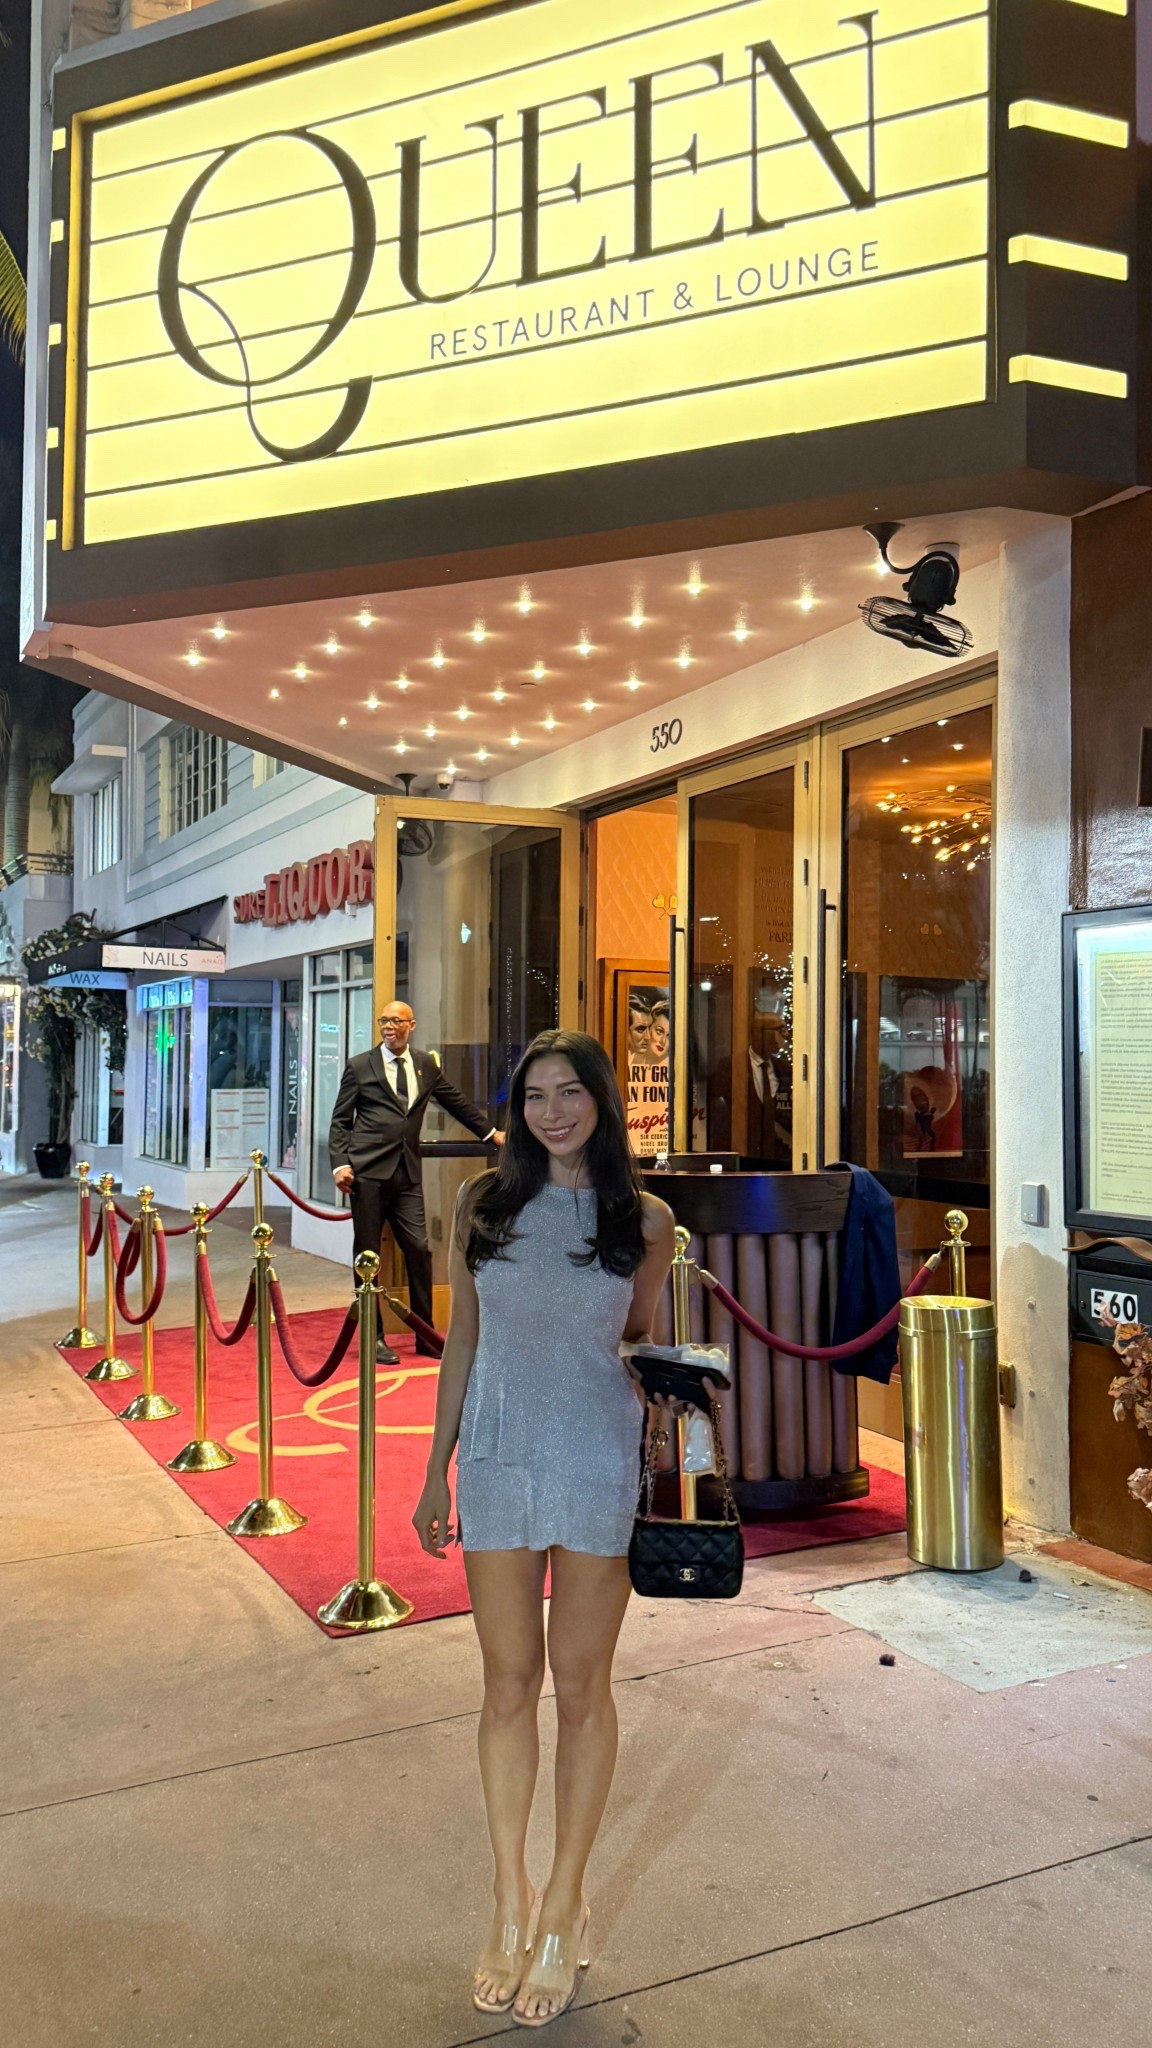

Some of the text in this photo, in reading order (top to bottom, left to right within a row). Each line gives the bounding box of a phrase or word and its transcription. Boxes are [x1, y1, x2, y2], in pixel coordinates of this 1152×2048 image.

[158, 10, 878, 462] QUEEN
[429, 241, 879, 360] RESTAURANT & LOUNGE
[650, 718, 683, 752] 550
[262, 840, 374, 927] LIQUOR
[70, 973, 100, 985] WAX
[142, 951, 188, 967] NAILS
[288, 1060, 297, 1114] NAILS
[1093, 1290, 1137, 1322] 560
